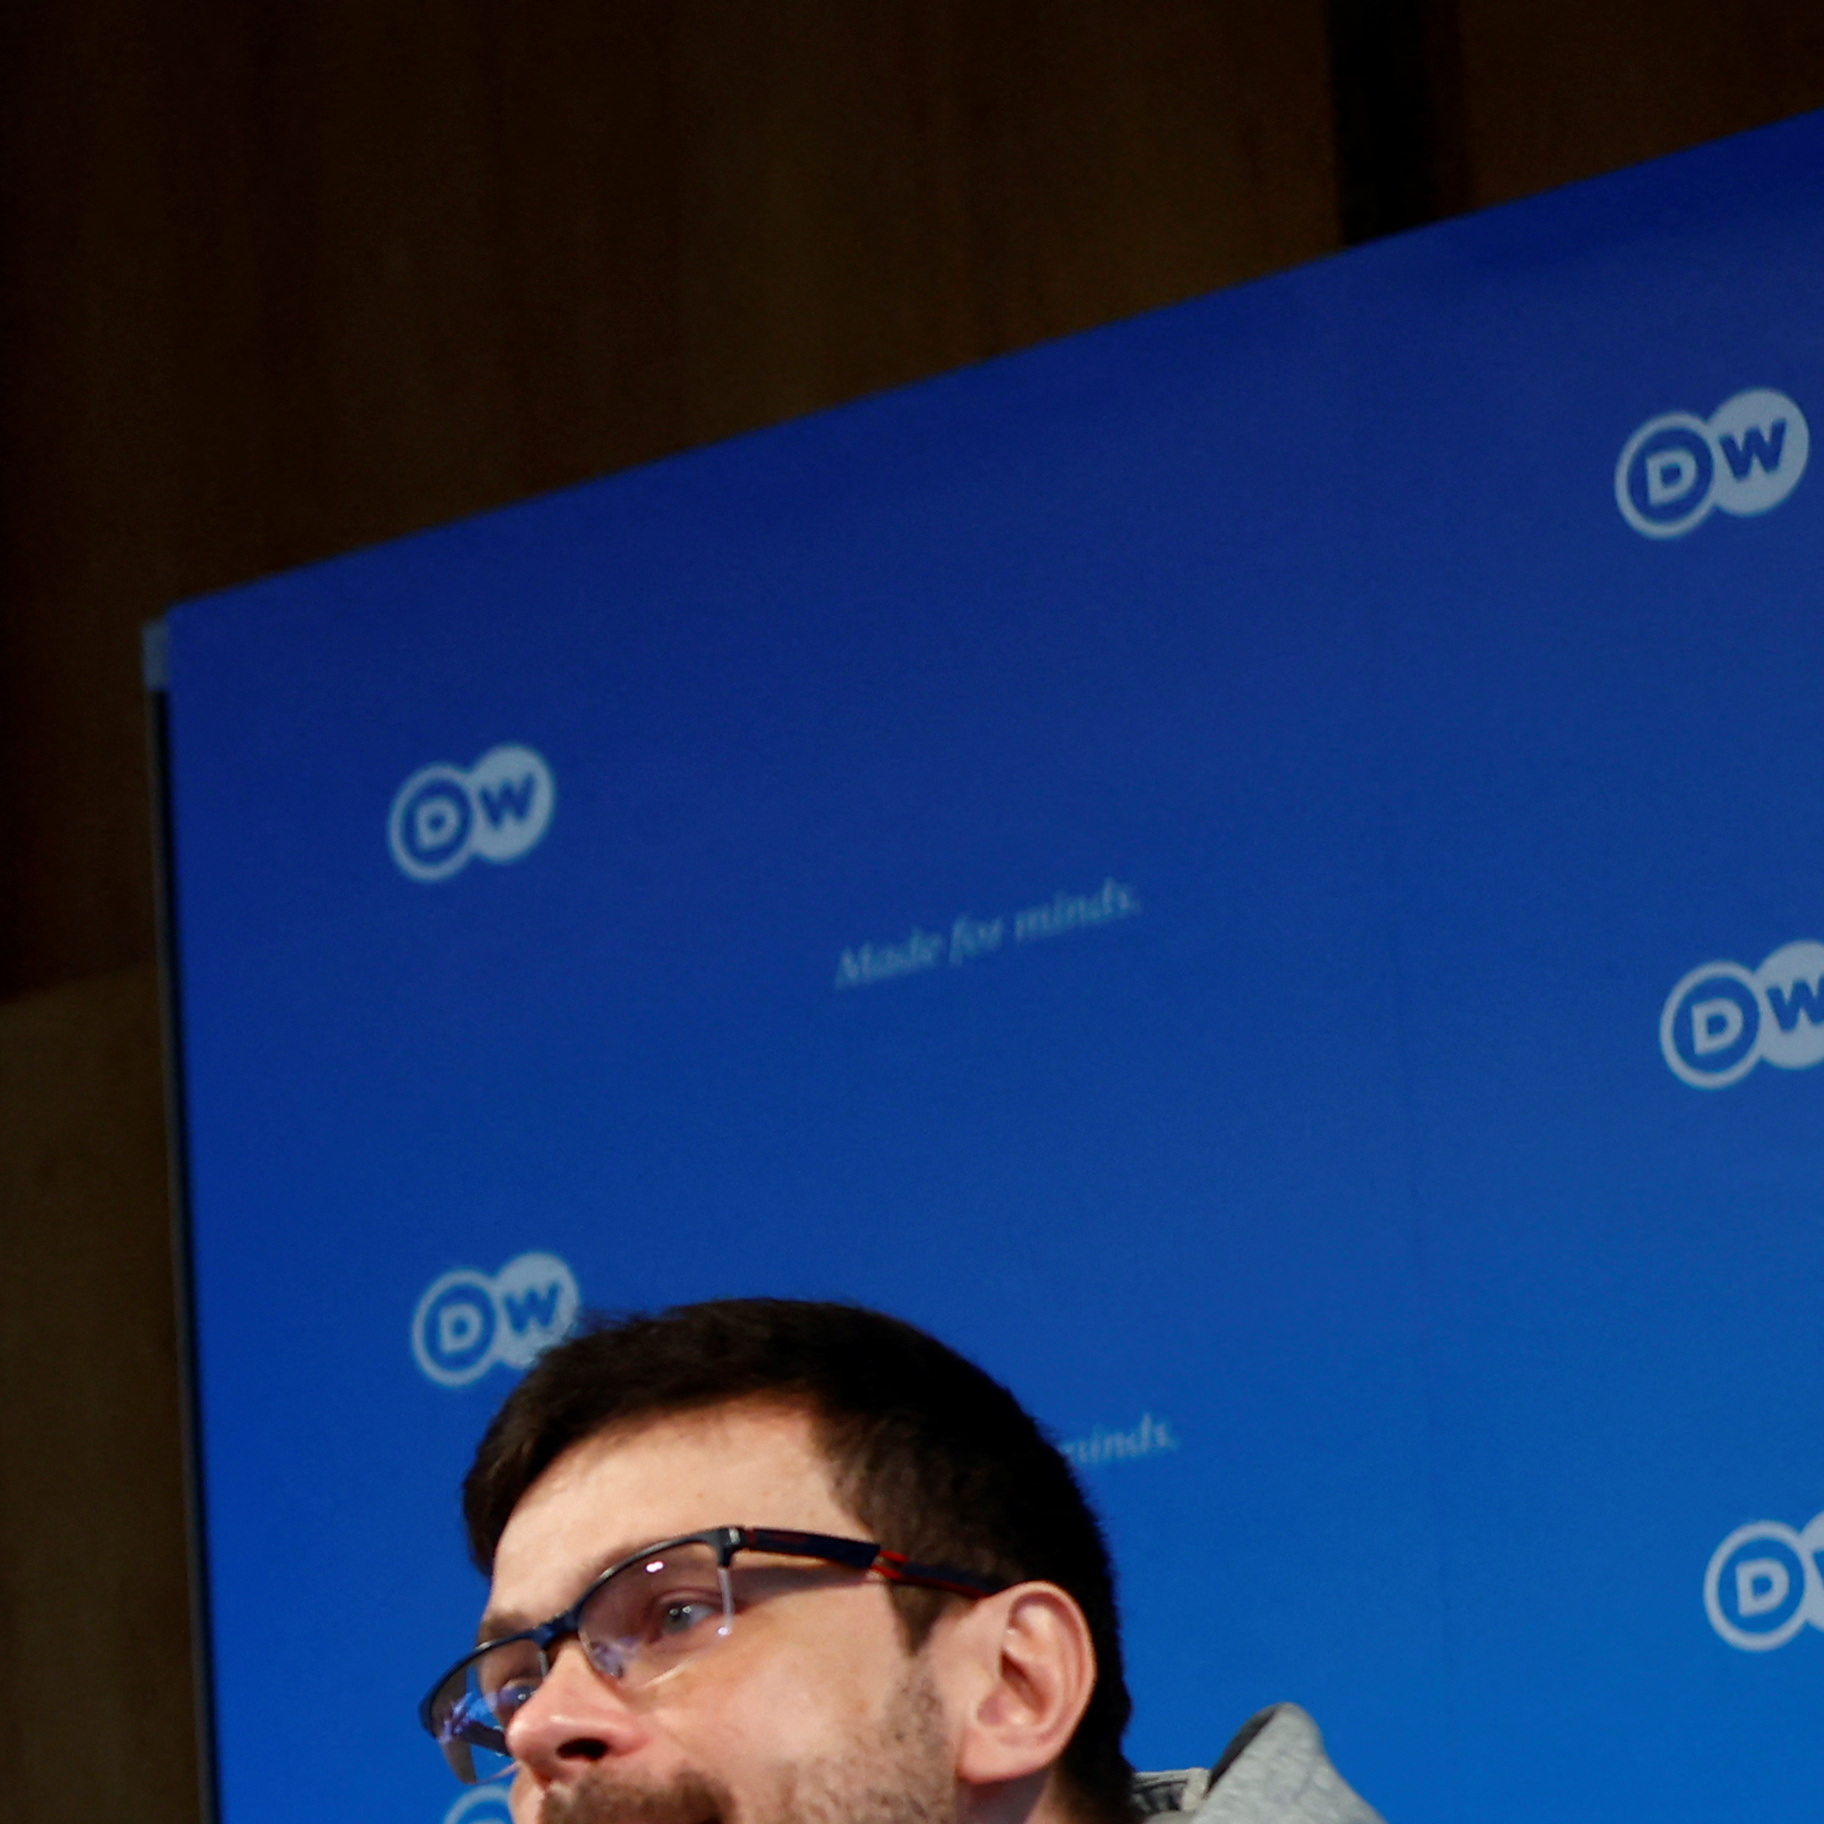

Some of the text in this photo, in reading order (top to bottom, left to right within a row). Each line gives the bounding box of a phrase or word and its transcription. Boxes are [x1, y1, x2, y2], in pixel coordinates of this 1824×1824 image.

[834, 877, 1141, 988] Made for minds.
